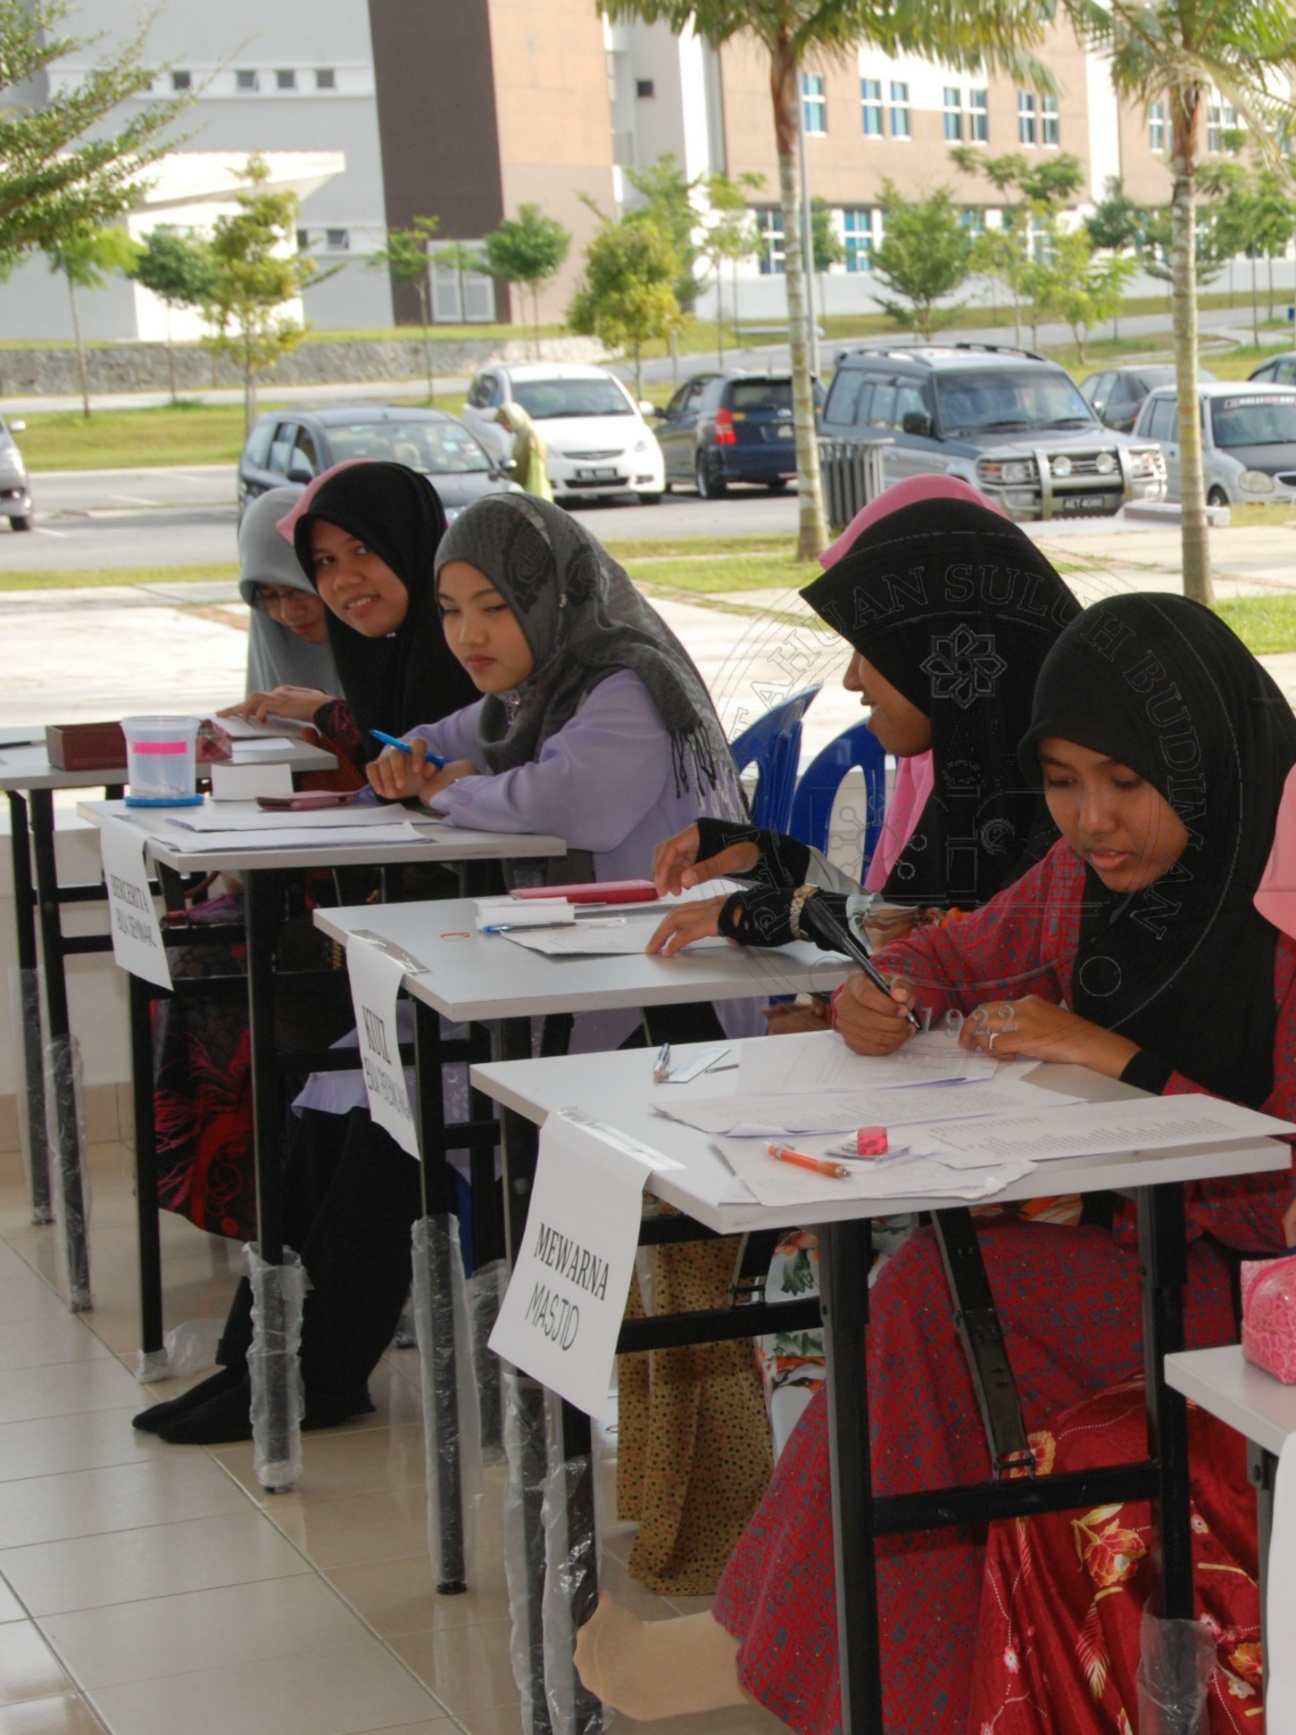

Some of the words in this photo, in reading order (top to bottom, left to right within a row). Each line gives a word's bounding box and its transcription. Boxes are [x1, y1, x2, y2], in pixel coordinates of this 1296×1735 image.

[362, 1004, 392, 1065] KUIZ
[533, 1222, 609, 1301] MEWARNA
[524, 1281, 580, 1351] MASJID
